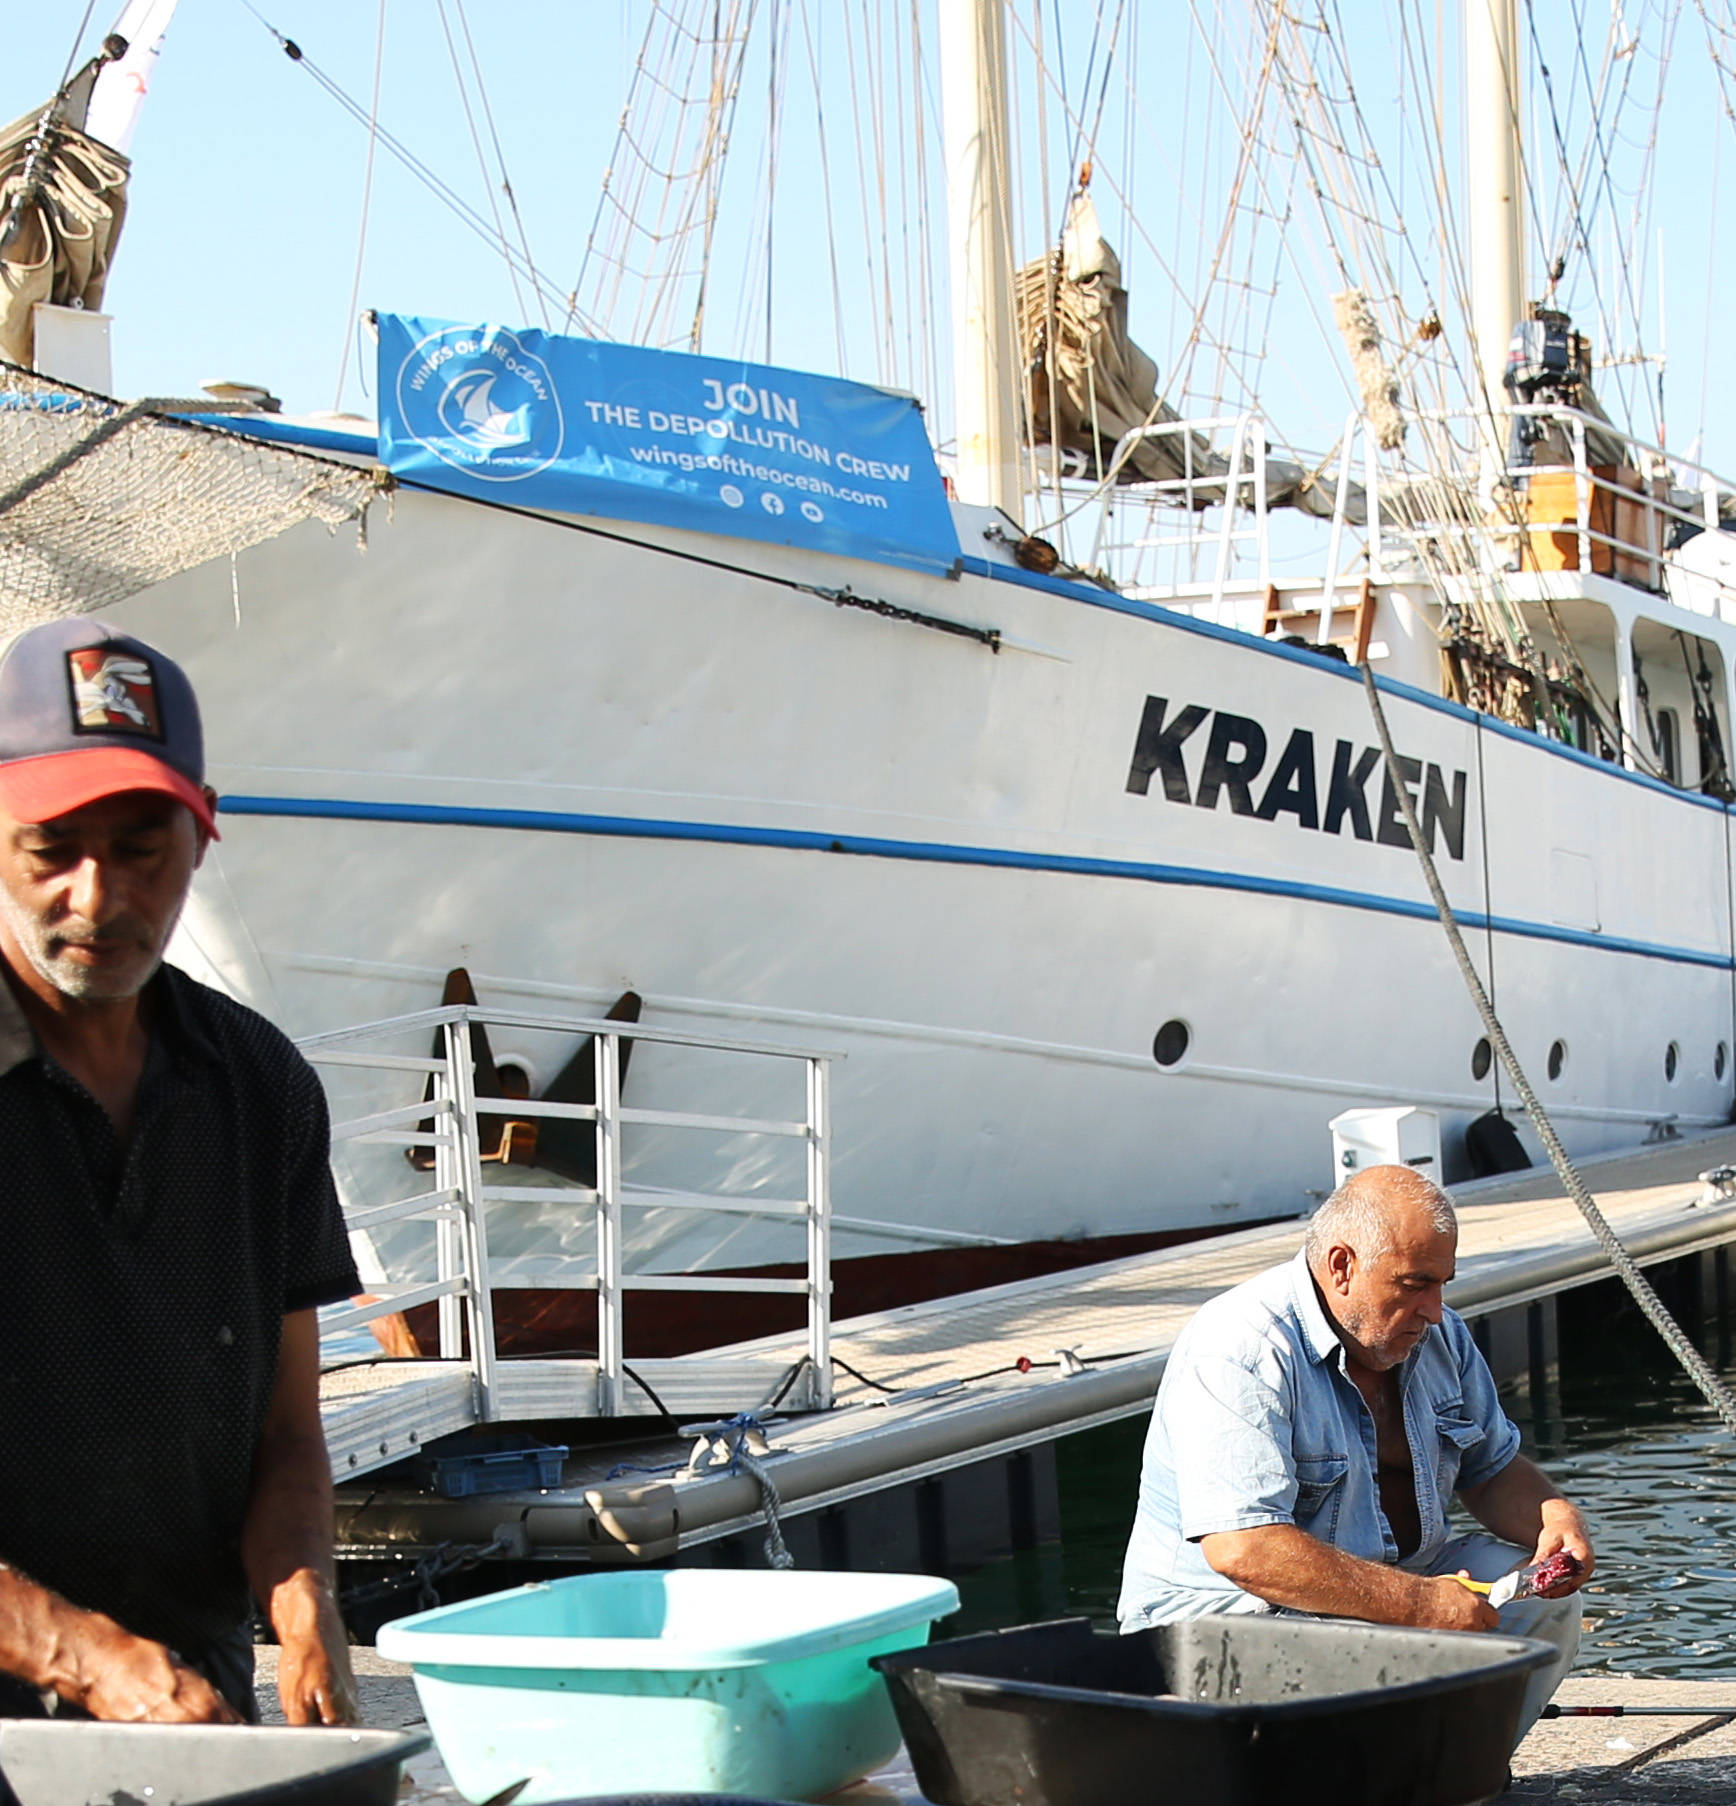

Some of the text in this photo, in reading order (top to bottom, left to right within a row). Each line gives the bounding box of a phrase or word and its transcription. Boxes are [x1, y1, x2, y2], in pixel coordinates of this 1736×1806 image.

[410, 345, 454, 392] WINGS
[454, 340, 478, 354] OF
[505, 357, 548, 400] OCEAN
[702, 379, 800, 429] JOIN
[585, 400, 911, 483] THE DEPOLLUTION CREW
[629, 446, 888, 509] wingsoftheocean.com
[1125, 694, 1467, 862] KRAKEN
